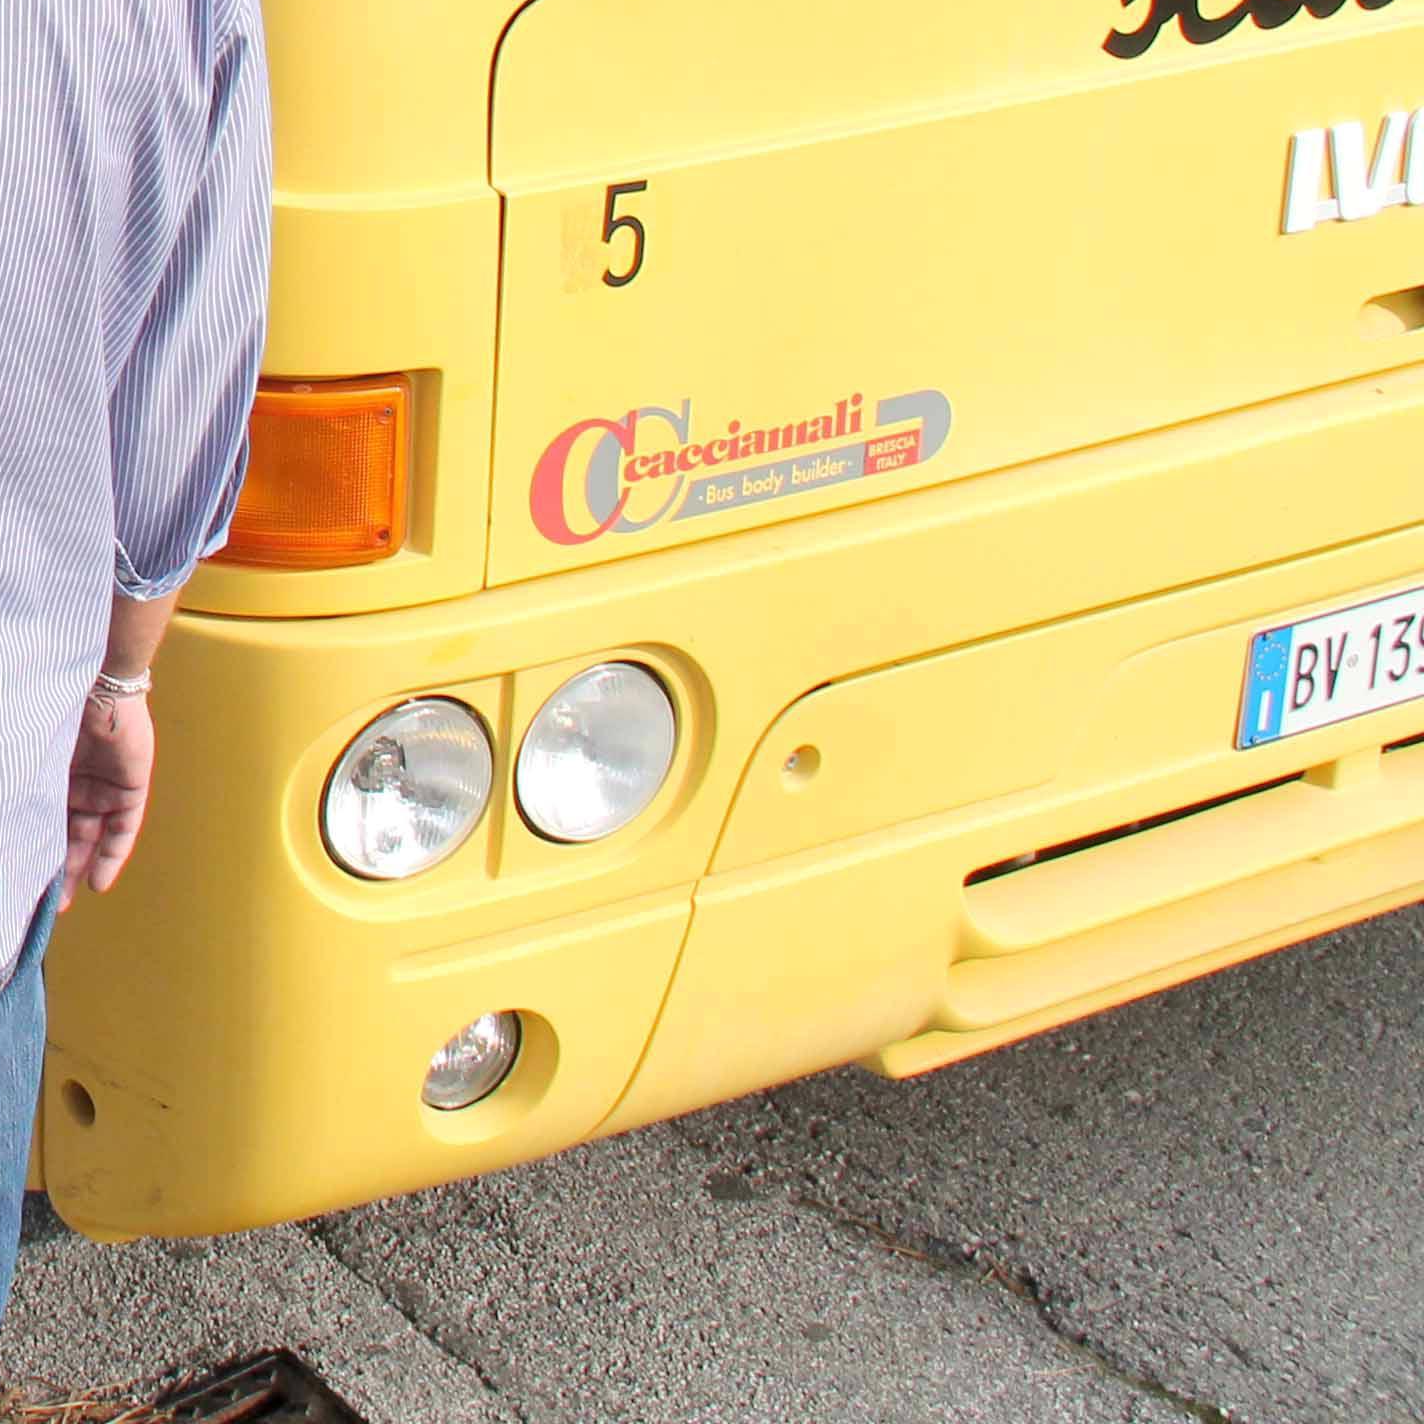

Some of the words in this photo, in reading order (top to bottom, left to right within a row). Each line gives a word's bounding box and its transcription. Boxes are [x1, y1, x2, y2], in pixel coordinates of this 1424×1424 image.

[601, 179, 648, 288] 5
[868, 437, 917, 458] BRESCIA
[876, 452, 907, 472] ITALY
[742, 466, 784, 495] body
[1289, 632, 1349, 712] BV
